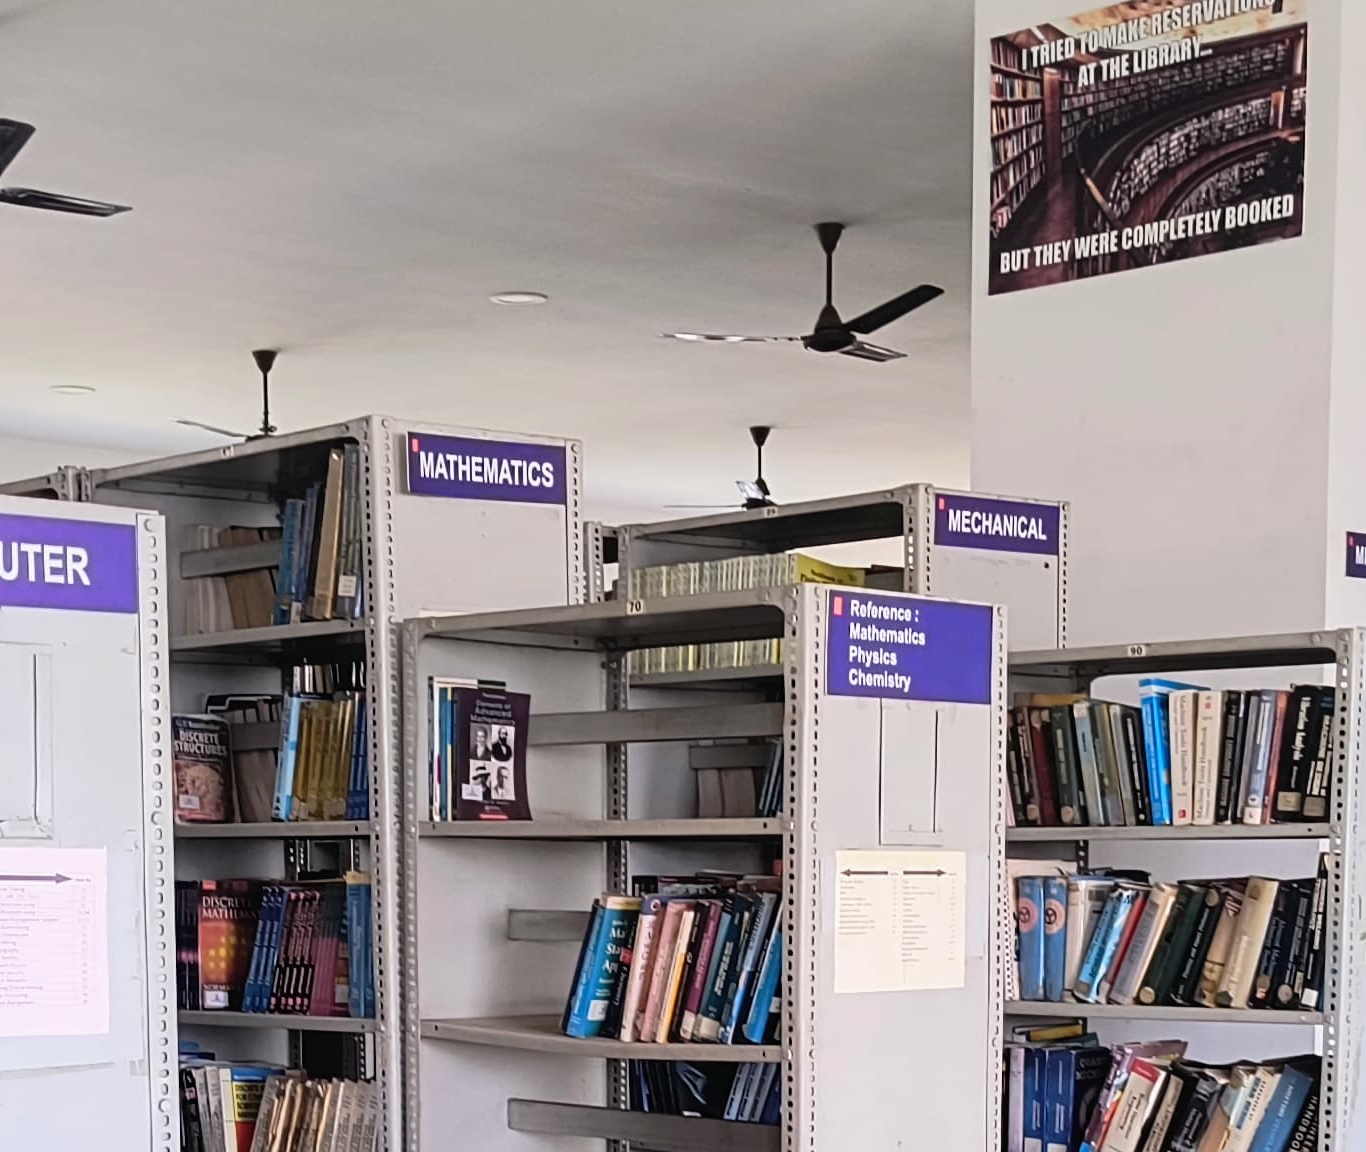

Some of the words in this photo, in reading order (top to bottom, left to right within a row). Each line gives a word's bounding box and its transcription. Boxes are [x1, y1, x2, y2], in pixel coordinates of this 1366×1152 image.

[1021, 48, 1029, 71] I
[1031, 37, 1076, 69] TRIED
[1080, 32, 1100, 56] TO
[1100, 19, 1149, 50] MAKE
[1078, 63, 1098, 87] AT
[1101, 56, 1130, 82] THE
[1000, 247, 1031, 274] BUT
[1034, 239, 1072, 268] THEY
[1074, 229, 1120, 261] WERE
[1121, 209, 1221, 249] COMPLETELY
[1224, 194, 1295, 229] BOOKED
[419, 451, 555, 488] MATHEMATICS
[948, 508, 1048, 541] MECHANICAL
[629, 600, 642, 612] 70
[850, 599, 912, 622] Reference
[849, 622, 926, 646] Mathematics
[849, 646, 898, 667] Physics
[849, 668, 912, 693] Chemistry
[1292, 1096, 1318, 1149] HANDBOO
